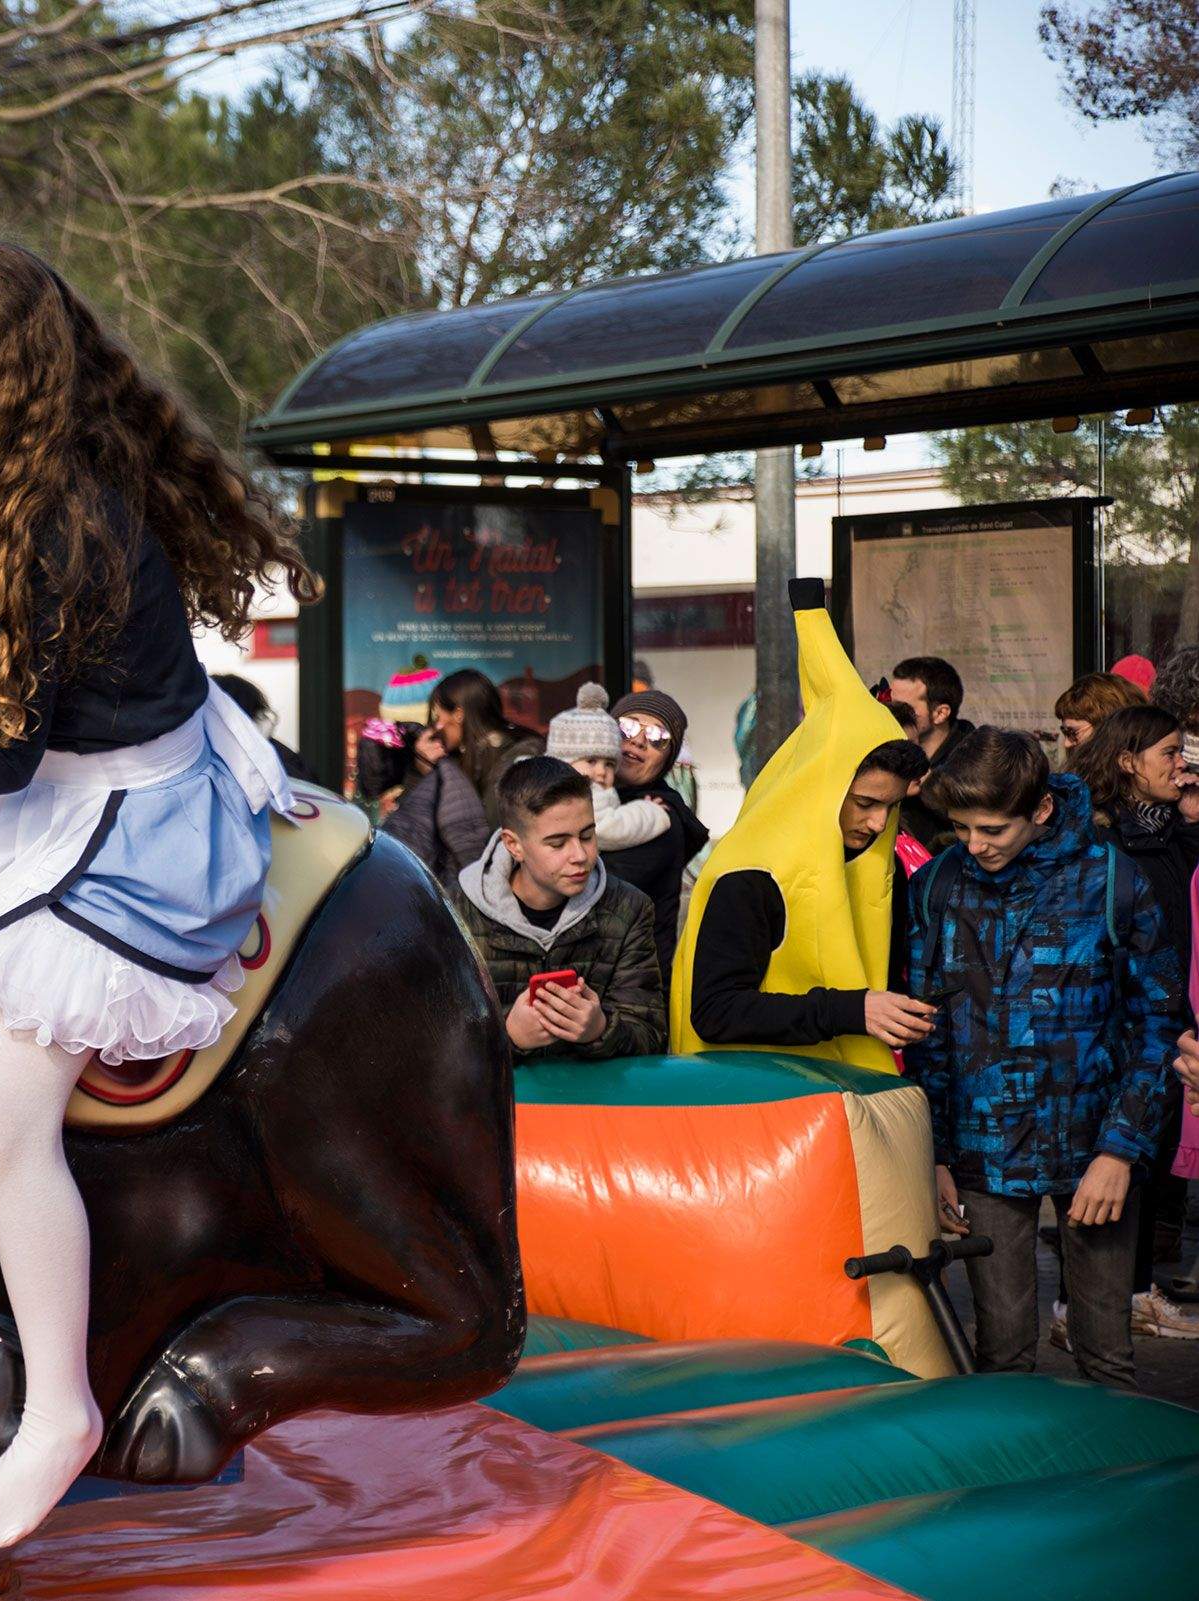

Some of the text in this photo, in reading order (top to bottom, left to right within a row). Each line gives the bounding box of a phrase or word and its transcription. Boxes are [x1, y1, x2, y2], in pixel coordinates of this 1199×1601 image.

[400, 522, 562, 577] Un Nadal
[443, 576, 484, 613] tot
[490, 576, 552, 613] tren
